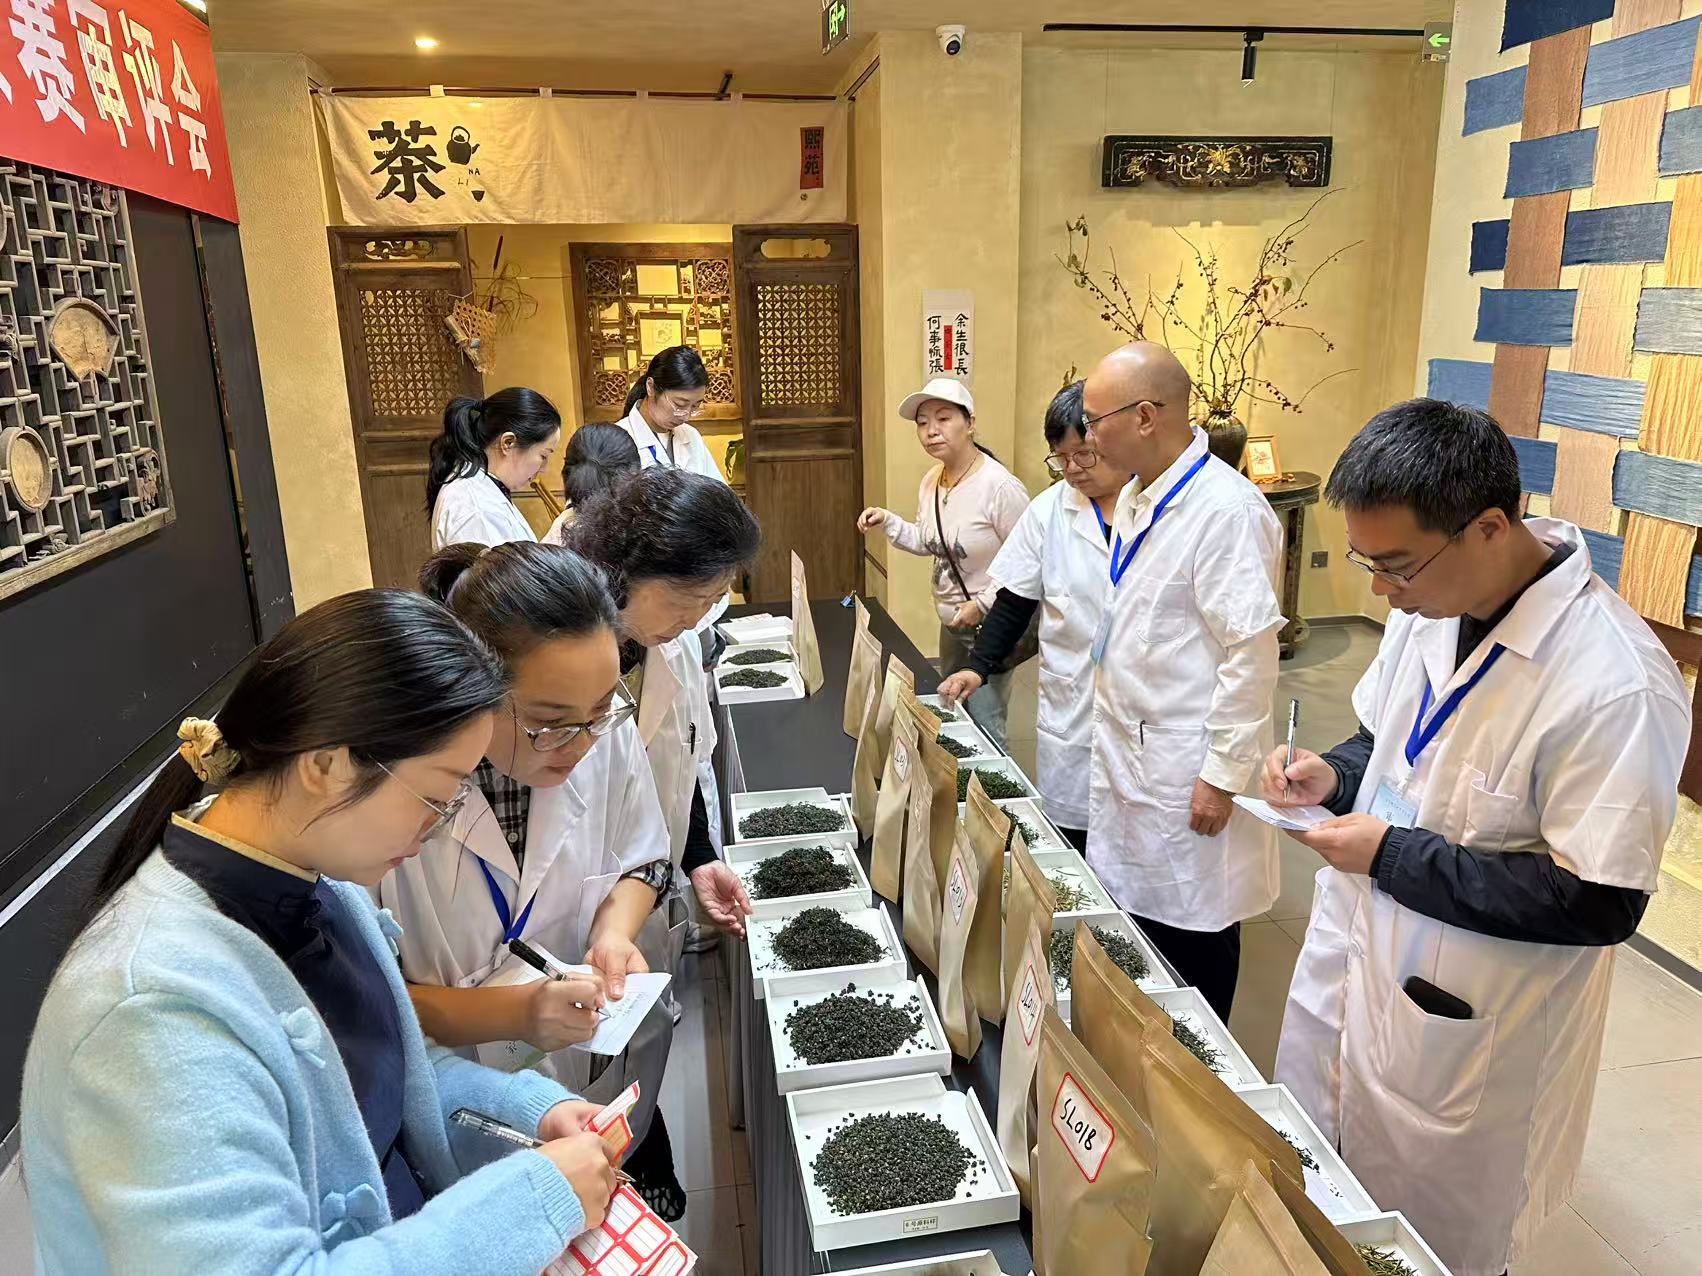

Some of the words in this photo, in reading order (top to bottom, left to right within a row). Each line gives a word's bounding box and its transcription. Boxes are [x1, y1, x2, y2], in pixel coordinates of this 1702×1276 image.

[0, 0, 211, 181] 赛审评会
[368, 120, 446, 203] 茶
[1060, 1098, 1097, 1150] SL018
